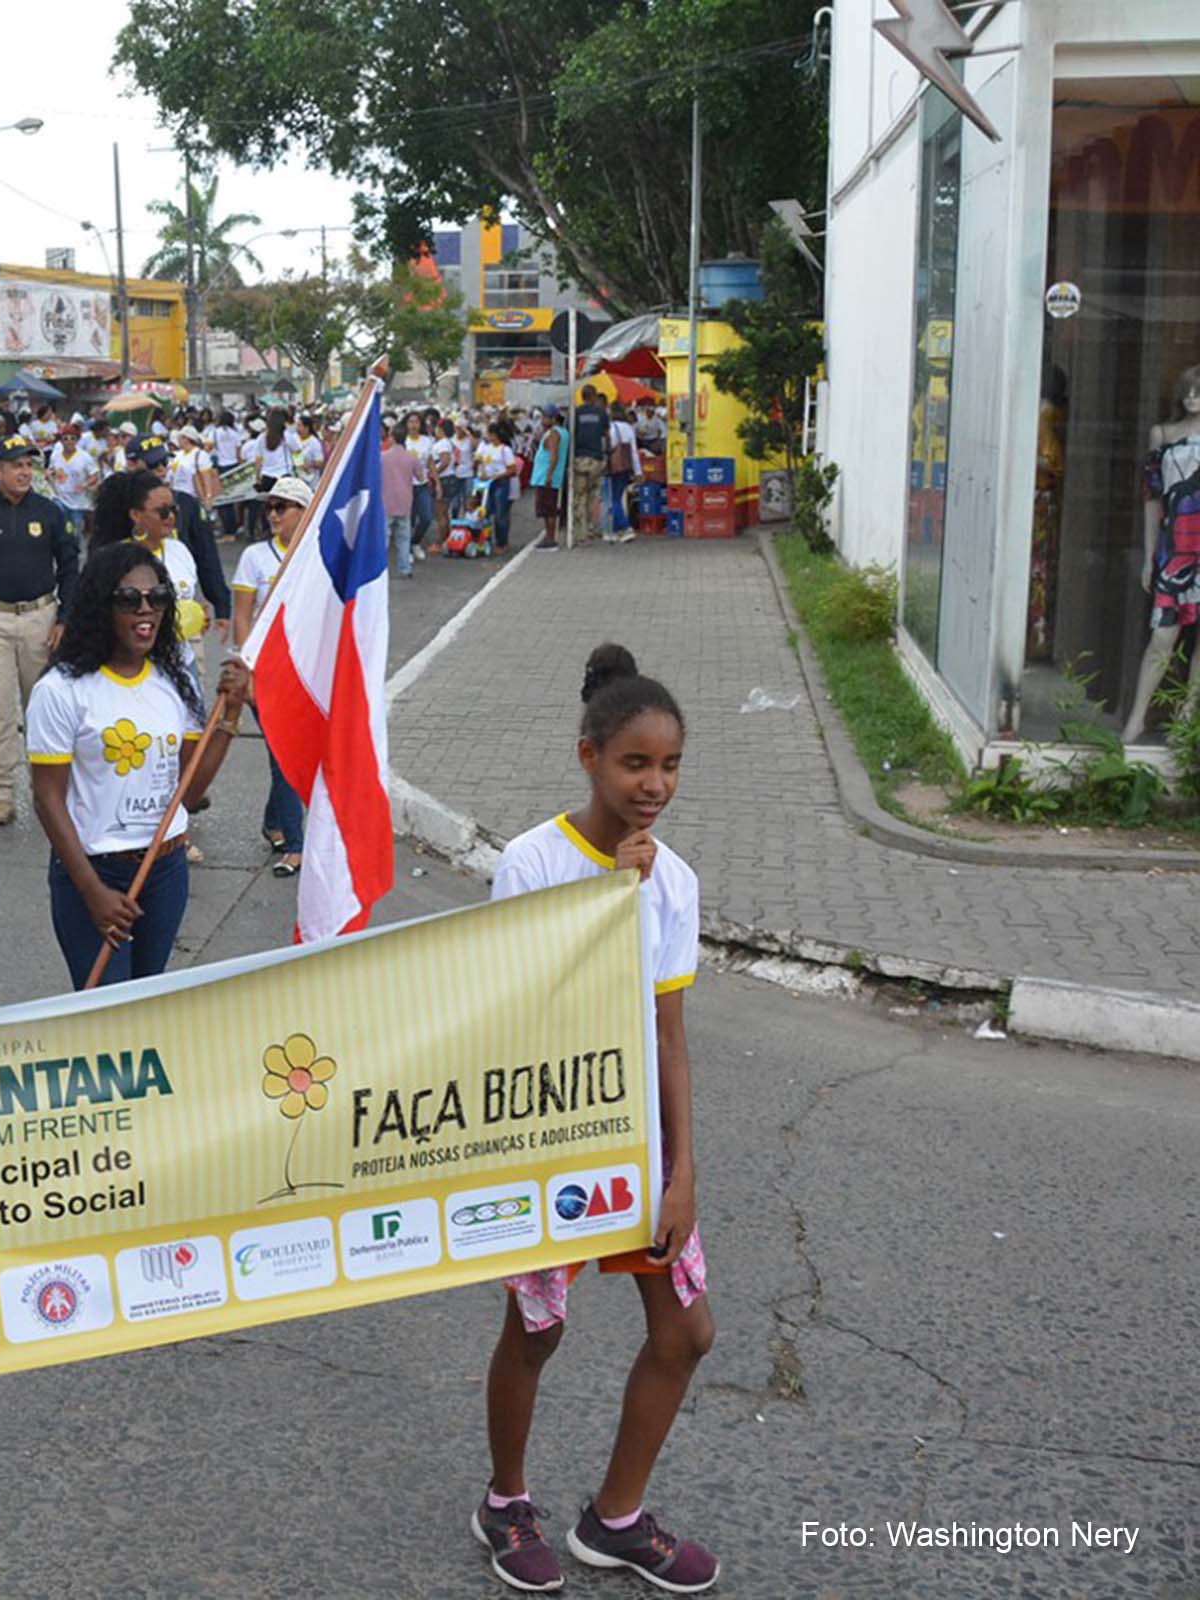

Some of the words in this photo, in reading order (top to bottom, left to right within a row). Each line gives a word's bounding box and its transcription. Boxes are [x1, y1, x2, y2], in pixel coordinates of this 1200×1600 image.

[352, 1080, 467, 1149] FAÇA
[484, 1048, 627, 1126] BONITO
[24, 1108, 132, 1143] FRENTE
[92, 1146, 132, 1174] de
[352, 1154, 406, 1179] PROTEJA
[409, 1146, 460, 1168] NOSSAS
[464, 1134, 525, 1160] CRIANÇAS
[529, 1131, 536, 1148] E
[43, 1182, 147, 1219] Social
[260, 1238, 331, 1260] BOULEVARD
